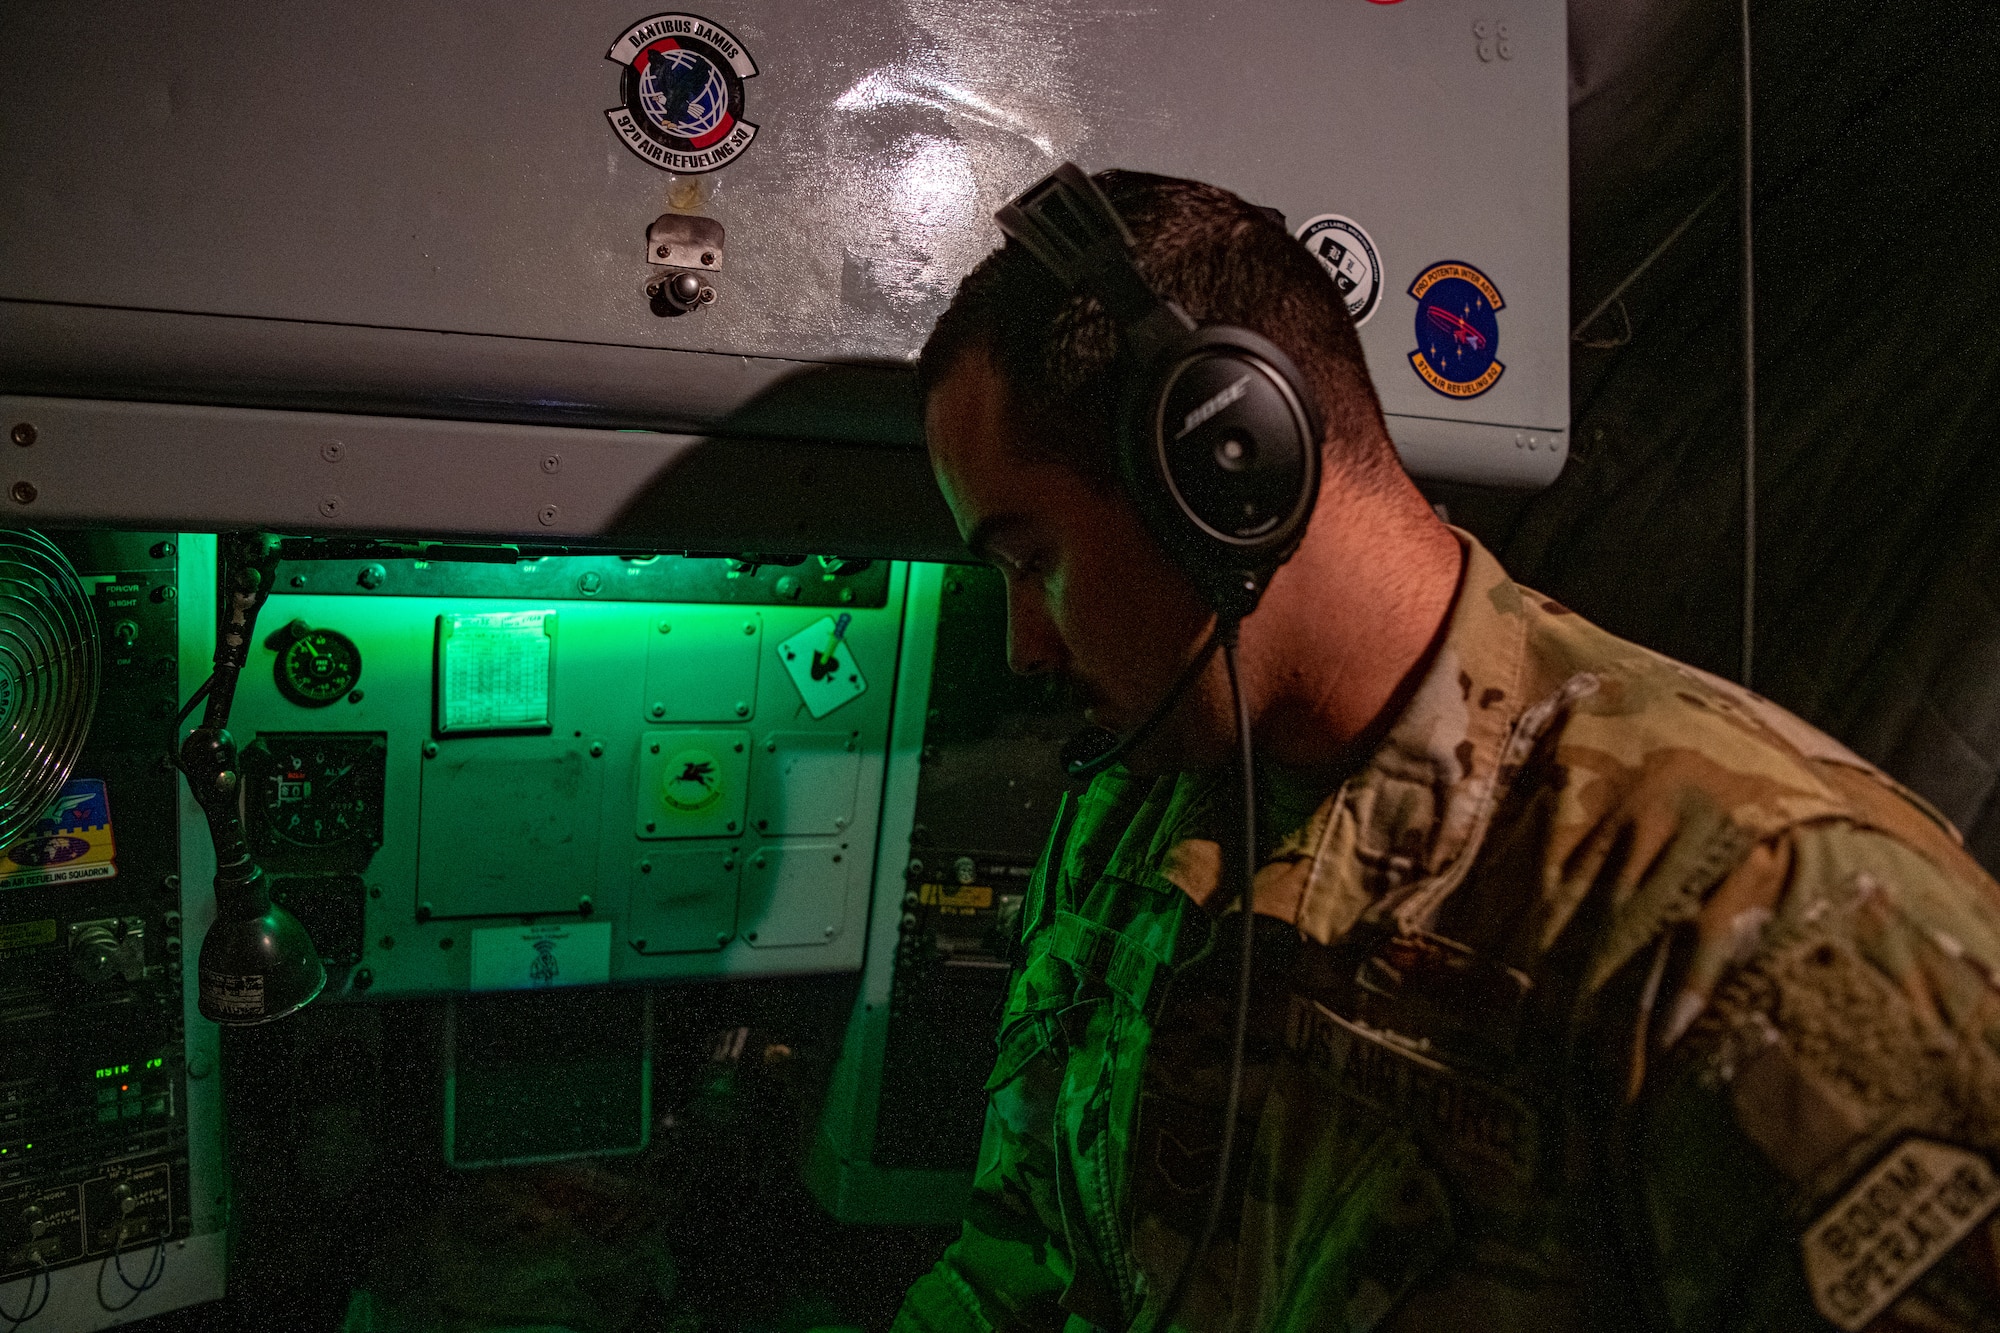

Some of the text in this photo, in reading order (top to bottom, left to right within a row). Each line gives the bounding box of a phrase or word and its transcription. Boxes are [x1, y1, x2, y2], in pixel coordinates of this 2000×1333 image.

[628, 20, 739, 59] DANTIBUS DAMUS
[617, 115, 750, 168] 92D AIR REFUELING SQ
[1415, 268, 1499, 307] PRO POTENTIA INTER ASTRA
[1432, 377, 1446, 389] AIR
[1447, 377, 1489, 394] REFUELING
[523, 565, 537, 573] OFF
[12, 877, 26, 887] AIR
[26, 873, 67, 885] REFUELING
[68, 867, 109, 879] SQUADRON
